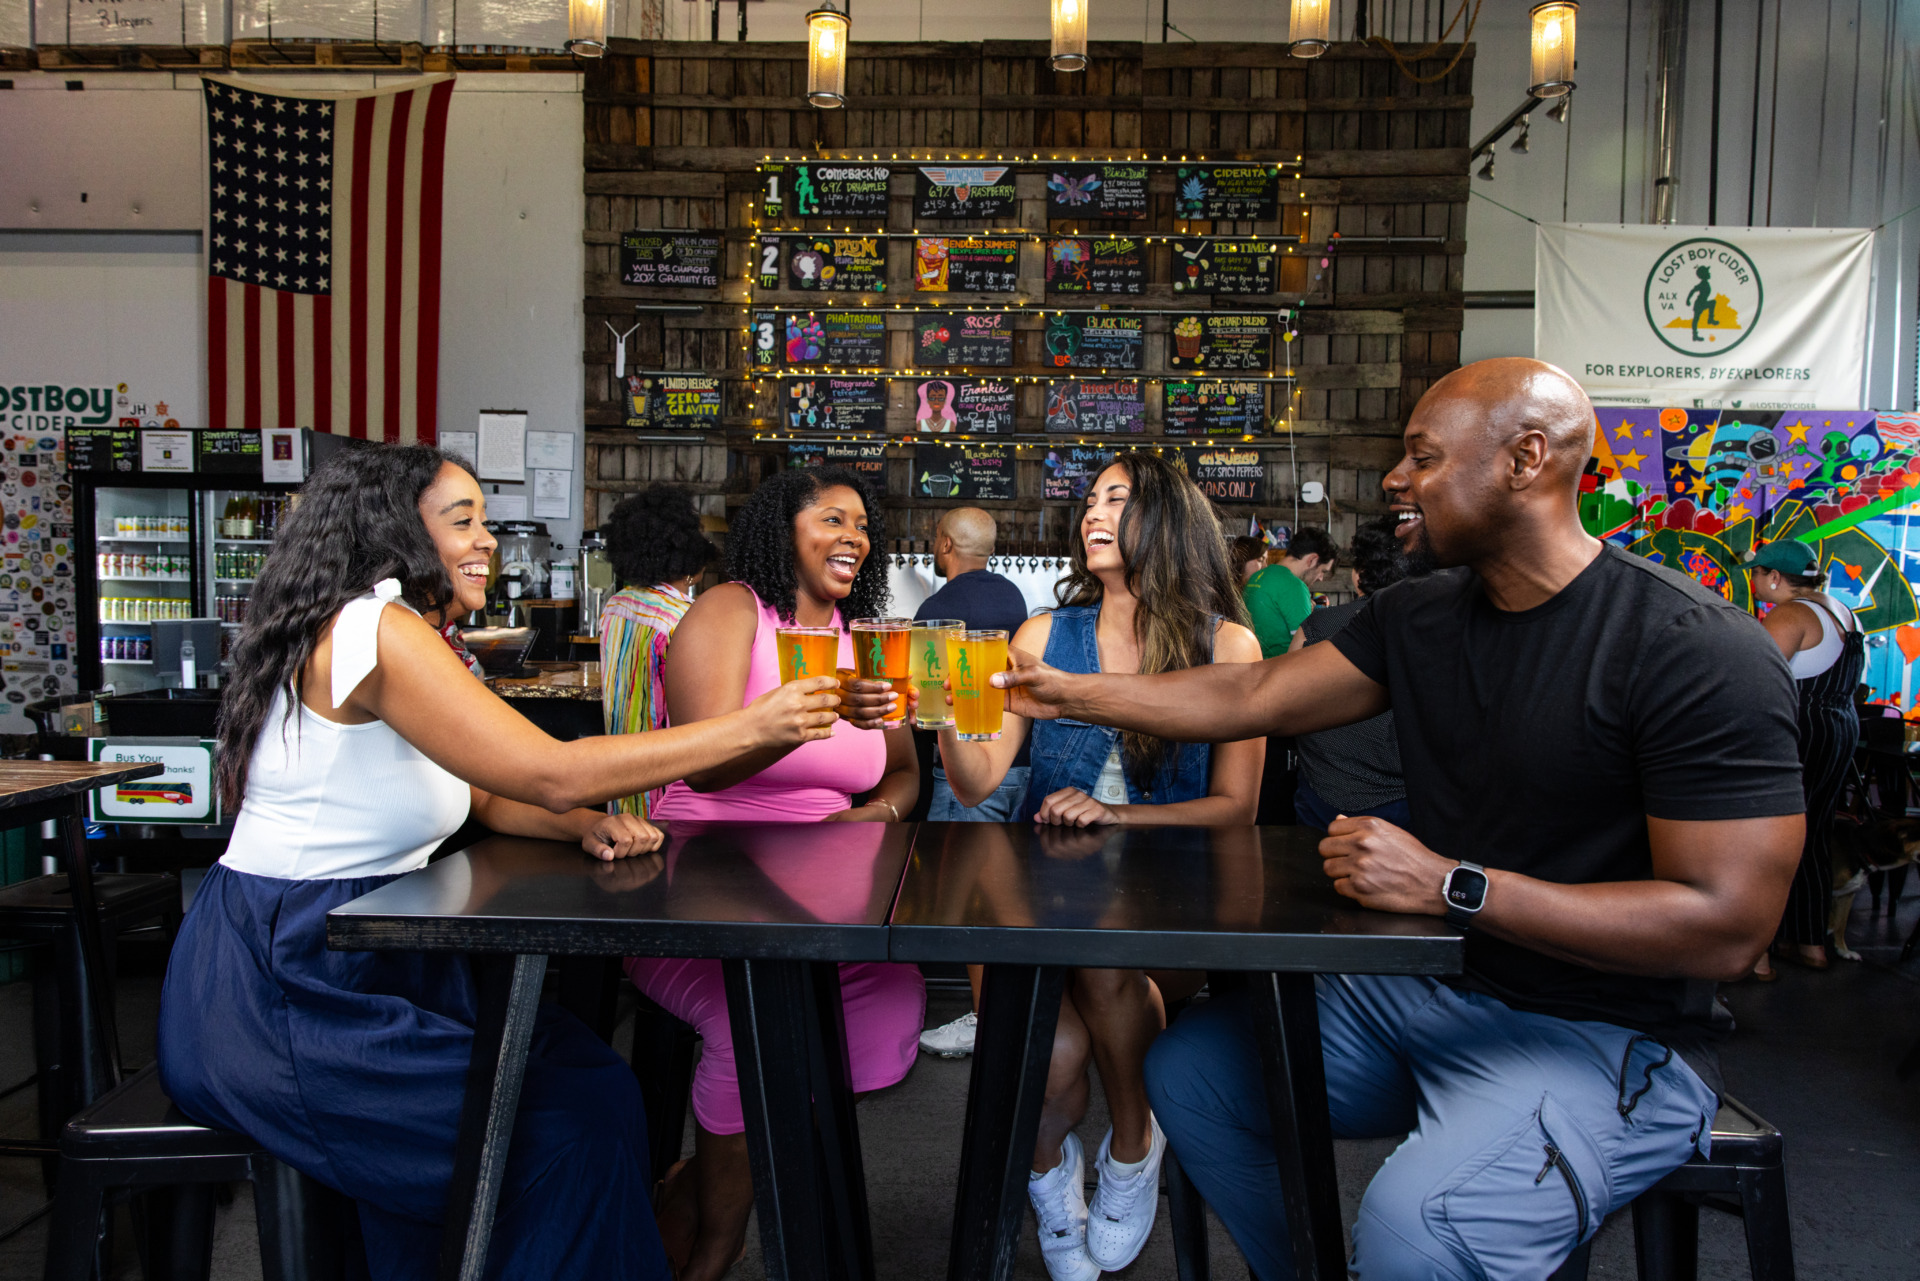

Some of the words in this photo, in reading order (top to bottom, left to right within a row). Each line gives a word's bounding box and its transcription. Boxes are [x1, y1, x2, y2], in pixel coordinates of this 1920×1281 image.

[97, 8, 111, 27] 3
[114, 10, 153, 30] layers
[945, 168, 984, 182] WINGMAN
[1213, 168, 1268, 179] CIDERITA
[765, 176, 783, 204] 1
[970, 185, 1016, 203] RASPBERRY
[627, 237, 663, 247] UNCLOSED
[761, 236, 780, 244] FLIGHT
[949, 239, 983, 249] ENDLESS
[984, 240, 1017, 249] SUMMER
[685, 247, 694, 257] 10
[833, 239, 878, 258] PLUM
[1114, 239, 1135, 254] Vida
[1213, 243, 1236, 253] TEE
[1239, 242, 1270, 253] TIME
[635, 248, 654, 258] TABS
[761, 245, 780, 275] 2
[632, 264, 656, 273] WILL
[657, 264, 671, 273] BE
[671, 265, 710, 274] CHARGED
[1658, 253, 1686, 285] LOST
[1687, 248, 1716, 261] BOY
[1718, 252, 1750, 286] CIDER
[624, 274, 632, 282] A
[633, 273, 656, 283] 20%
[658, 273, 701, 285] GRATUITY
[702, 275, 718, 286] FEE
[1658, 292, 1678, 301] ALX
[1661, 303, 1675, 311] VA
[757, 312, 776, 320] FLIGHT
[826, 313, 884, 324] PHANTASMAL
[1207, 316, 1243, 327] ORCHARD
[1242, 316, 1268, 326] BLEND
[1087, 315, 1118, 329] BLACK
[1117, 317, 1143, 330] TWIG
[757, 322, 775, 350] 3
[1585, 363, 1614, 377] FOR
[1619, 364, 1706, 381] EXPLORERS,
[1708, 367, 1727, 381] BY
[1726, 367, 1811, 381] EXPLORERS
[960, 382, 1010, 397] Frankie
[1079, 382, 1139, 395] merlot
[1197, 383, 1229, 395] APPLE
[1229, 382, 1258, 394] WINE
[666, 392, 701, 405] ZERO
[130, 403, 147, 416] JH
[668, 403, 721, 416] GRAVITY
[1749, 400, 1817, 410] @LOSTBOYCIDER
[860, 446, 884, 456] ONLY
[964, 449, 1008, 460] Margarita
[855, 462, 884, 472] PEACHY
[971, 459, 1003, 467] SLUSHY
[1197, 466, 1217, 478] 6.9%
[1217, 466, 1236, 478] SPICY
[1236, 466, 1264, 478] PEPPERS
[1228, 481, 1257, 499] ONLY
[116, 753, 135, 763] Bus
[138, 753, 163, 763] Your
